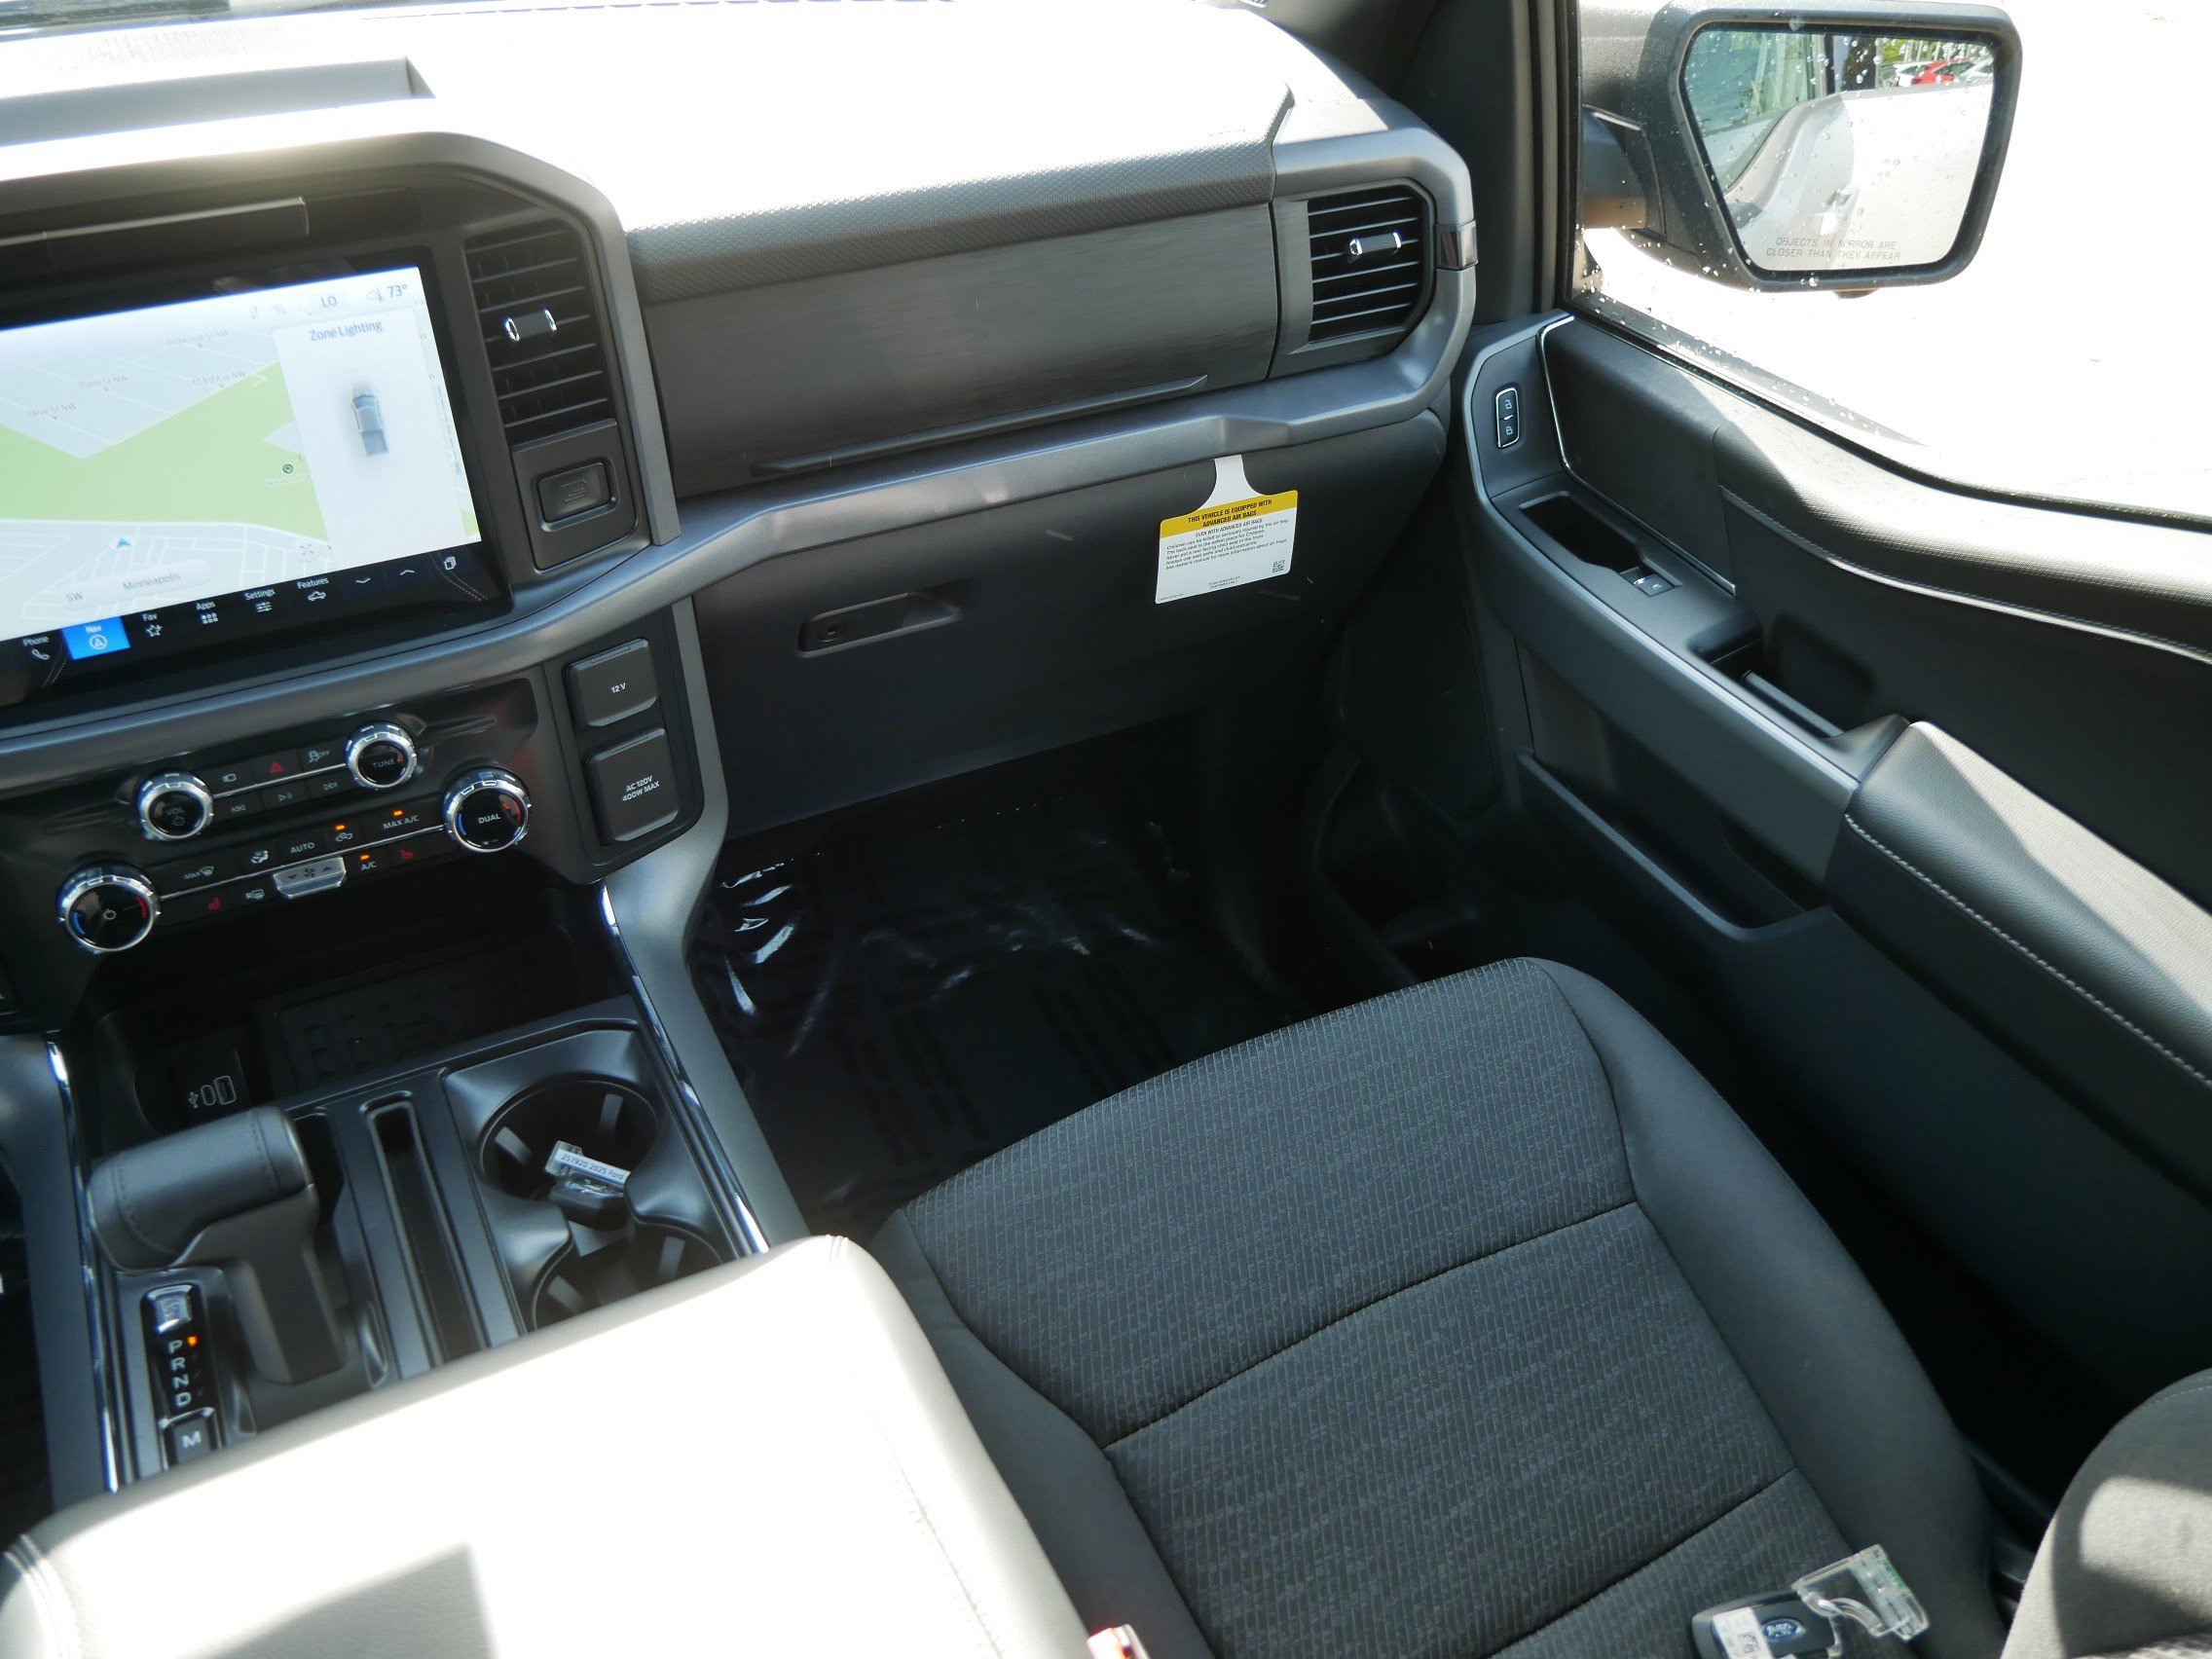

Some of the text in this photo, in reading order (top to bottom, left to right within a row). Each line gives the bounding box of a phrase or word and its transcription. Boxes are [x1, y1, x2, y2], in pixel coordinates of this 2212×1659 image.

[1775, 237, 1819, 247] OBJECTS
[1823, 239, 1833, 247] IN
[1877, 240, 1898, 249] ARE
[1766, 247, 1901, 260] CLOSER THAN THEY APPEAR
[321, 296, 337, 308] LO
[309, 320, 384, 342] Zone Lighting
[1201, 509, 1224, 520] VEHICLE
[1231, 502, 1258, 513] EQUIPPED
[1258, 498, 1272, 507] WITH
[1202, 516, 1232, 527] ADVANCED
[122, 572, 181, 591] Minneapolis
[297, 577, 329, 589] Features
[66, 591, 83, 603] SW
[244, 588, 276, 601] Settings
[196, 601, 215, 610] Apps
[142, 612, 157, 622] Fav
[85, 624, 102, 634] Nav
[22, 635, 50, 646] Phone
[610, 683, 620, 694] 12
[318, 750, 330, 758] OFF
[372, 758, 396, 769] TUNE
[625, 775, 653, 793] AC 120V
[621, 780, 660, 802] 400W MAX
[165, 807, 185, 816] VOL
[383, 815, 420, 830] MAX A/C
[477, 813, 501, 825] DUAL
[290, 842, 315, 854] AUTO
[360, 861, 378, 871] A/C
[184, 871, 201, 880] MAX
[562, 1154, 624, 1180] 257920 2025 Ford
[168, 1339, 183, 1353] P
[170, 1356, 186, 1372] R
[172, 1373, 189, 1389] N
[174, 1391, 192, 1407] D
[182, 1430, 202, 1449] M
